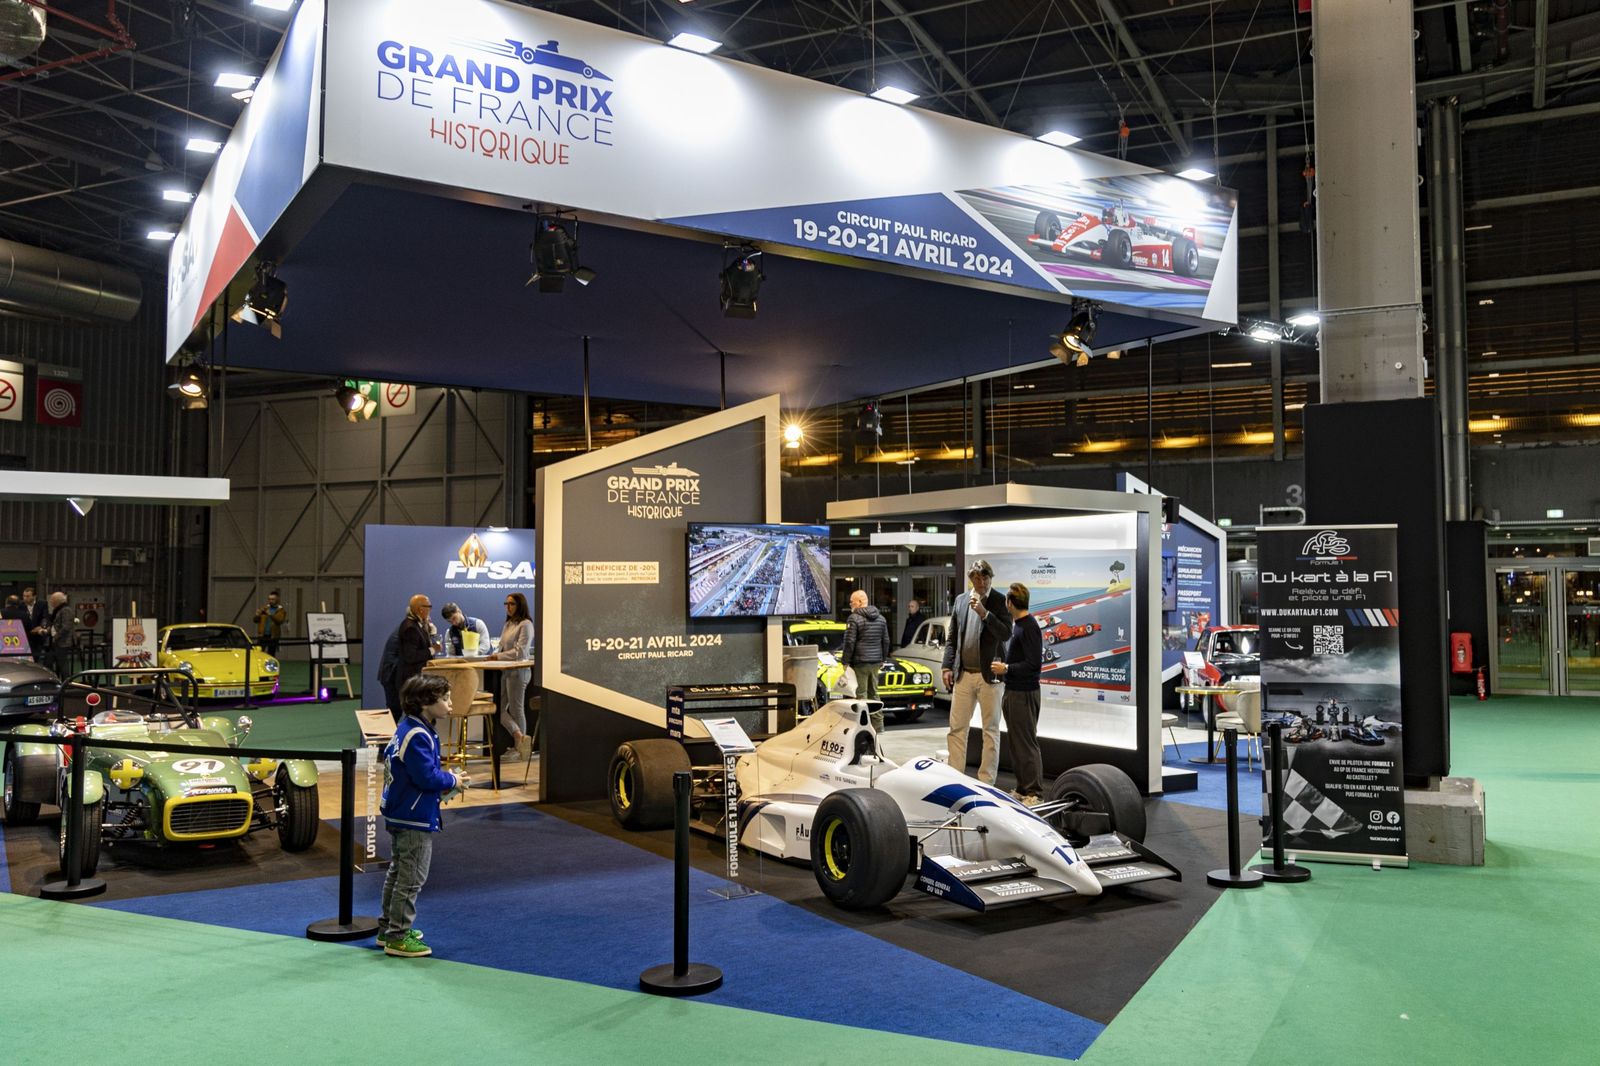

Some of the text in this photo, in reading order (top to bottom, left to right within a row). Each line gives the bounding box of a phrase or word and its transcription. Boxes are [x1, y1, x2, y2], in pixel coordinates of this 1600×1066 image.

[377, 40, 613, 117] GRAND PRIX
[377, 70, 613, 146] DE FRANCE
[430, 117, 570, 165] HISTORIQUE
[837, 211, 977, 248] CIRCUIT PAUL RICARD
[793, 218, 1014, 278] 19-20-21 AVRIL 2024
[1162, 249, 1170, 267] 14
[607, 475, 700, 492] GRAND PRIX
[607, 490, 700, 505] DE FRANCE
[1286, 485, 1303, 505] 3
[627, 505, 683, 519] HISTORIQUE
[445, 560, 535, 580] FFSA
[1261, 570, 1393, 583] Du kart à la F1
[1302, 594, 1329, 602] pilote
[586, 634, 722, 651] 19-20-21 AVRIL 2024
[618, 650, 693, 660] CIRCUIT PAUL RICARD
[1071, 670, 1126, 682] 19-20-21 AVRIL 2024
[179, 760, 217, 771] 91
[727, 756, 736, 780] AGS
[727, 781, 737, 796] 25
[367, 788, 377, 822] SEVEN
[728, 798, 737, 811] JH
[366, 824, 376, 859] LOTUS
[728, 820, 739, 877] FORMULE
